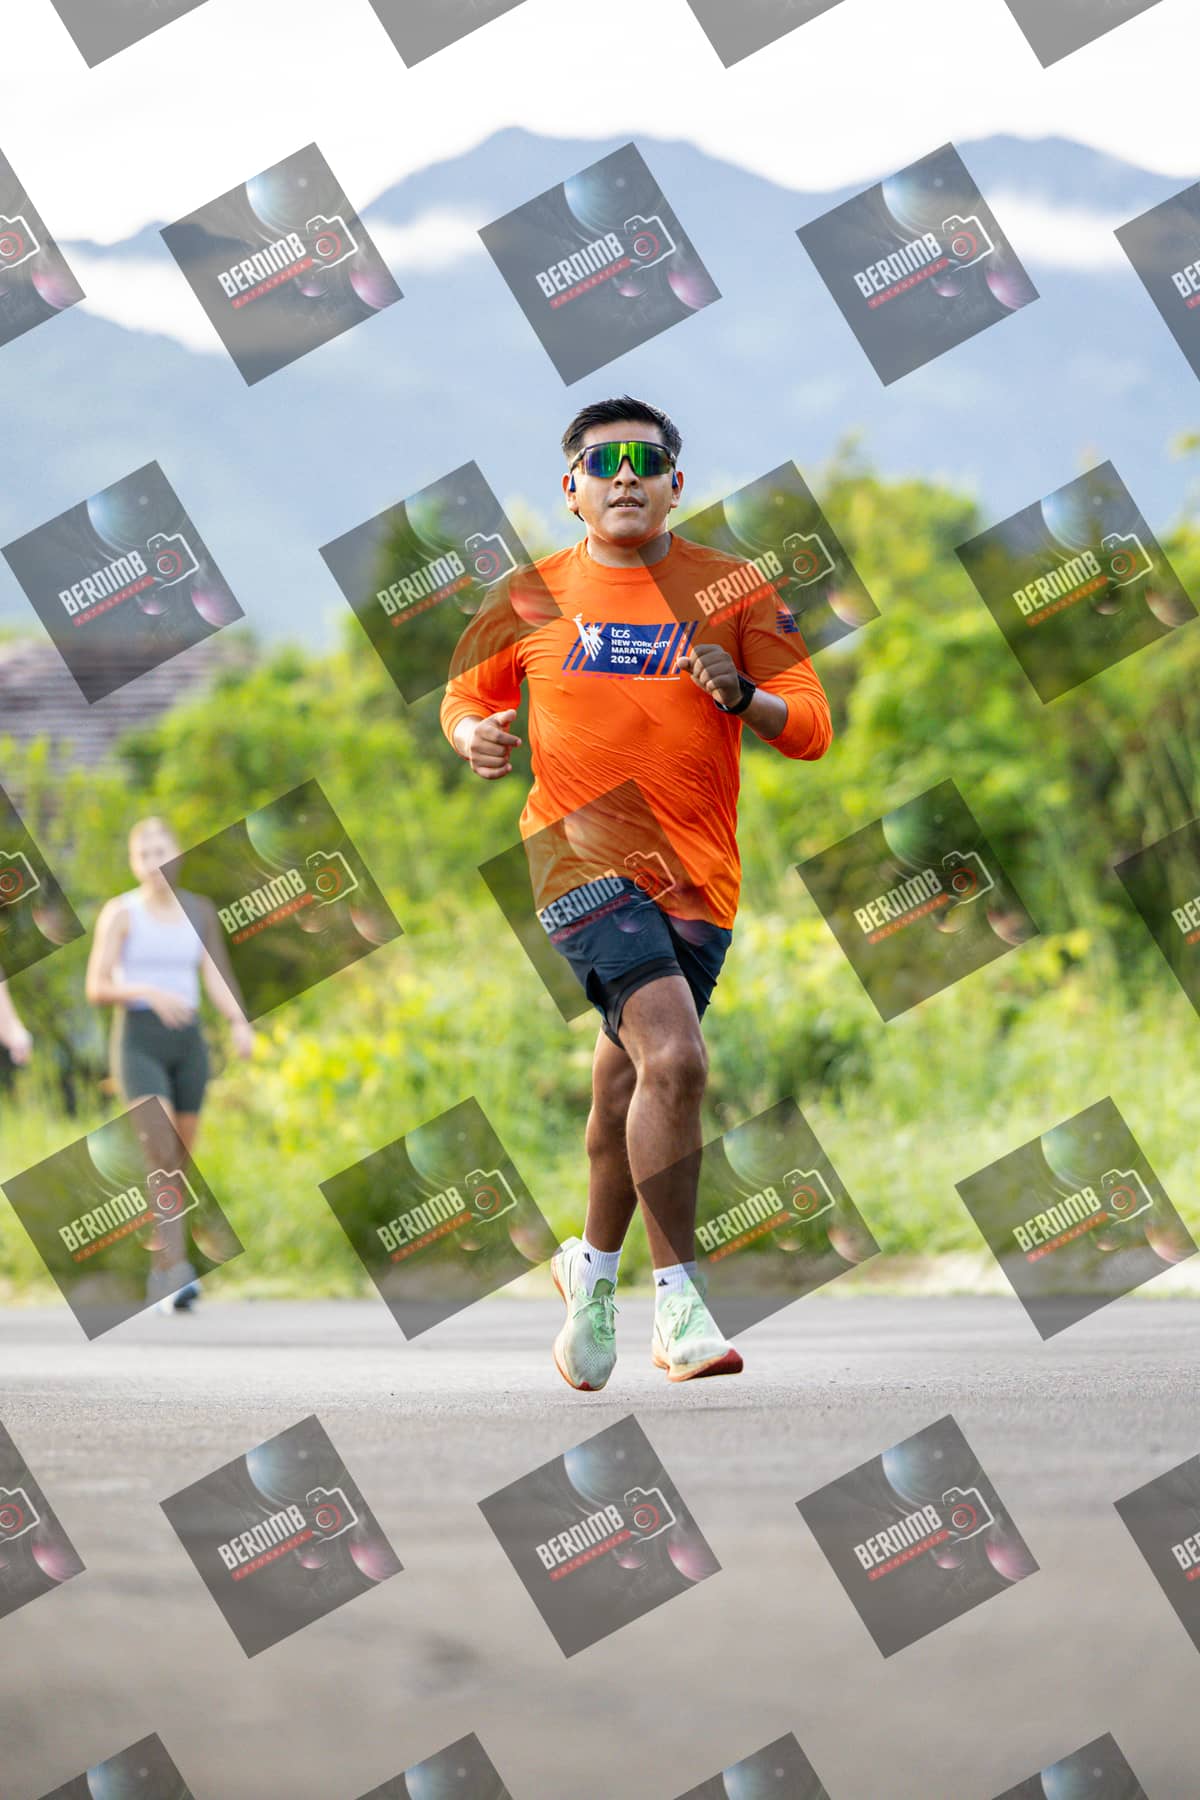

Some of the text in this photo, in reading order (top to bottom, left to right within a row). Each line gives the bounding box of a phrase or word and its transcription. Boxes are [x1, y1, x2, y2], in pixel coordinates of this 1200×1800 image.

[632, 640, 652, 648] YORK
[653, 640, 671, 649] CITY
[611, 647, 657, 655] MARATHON
[610, 655, 638, 664] 2024
